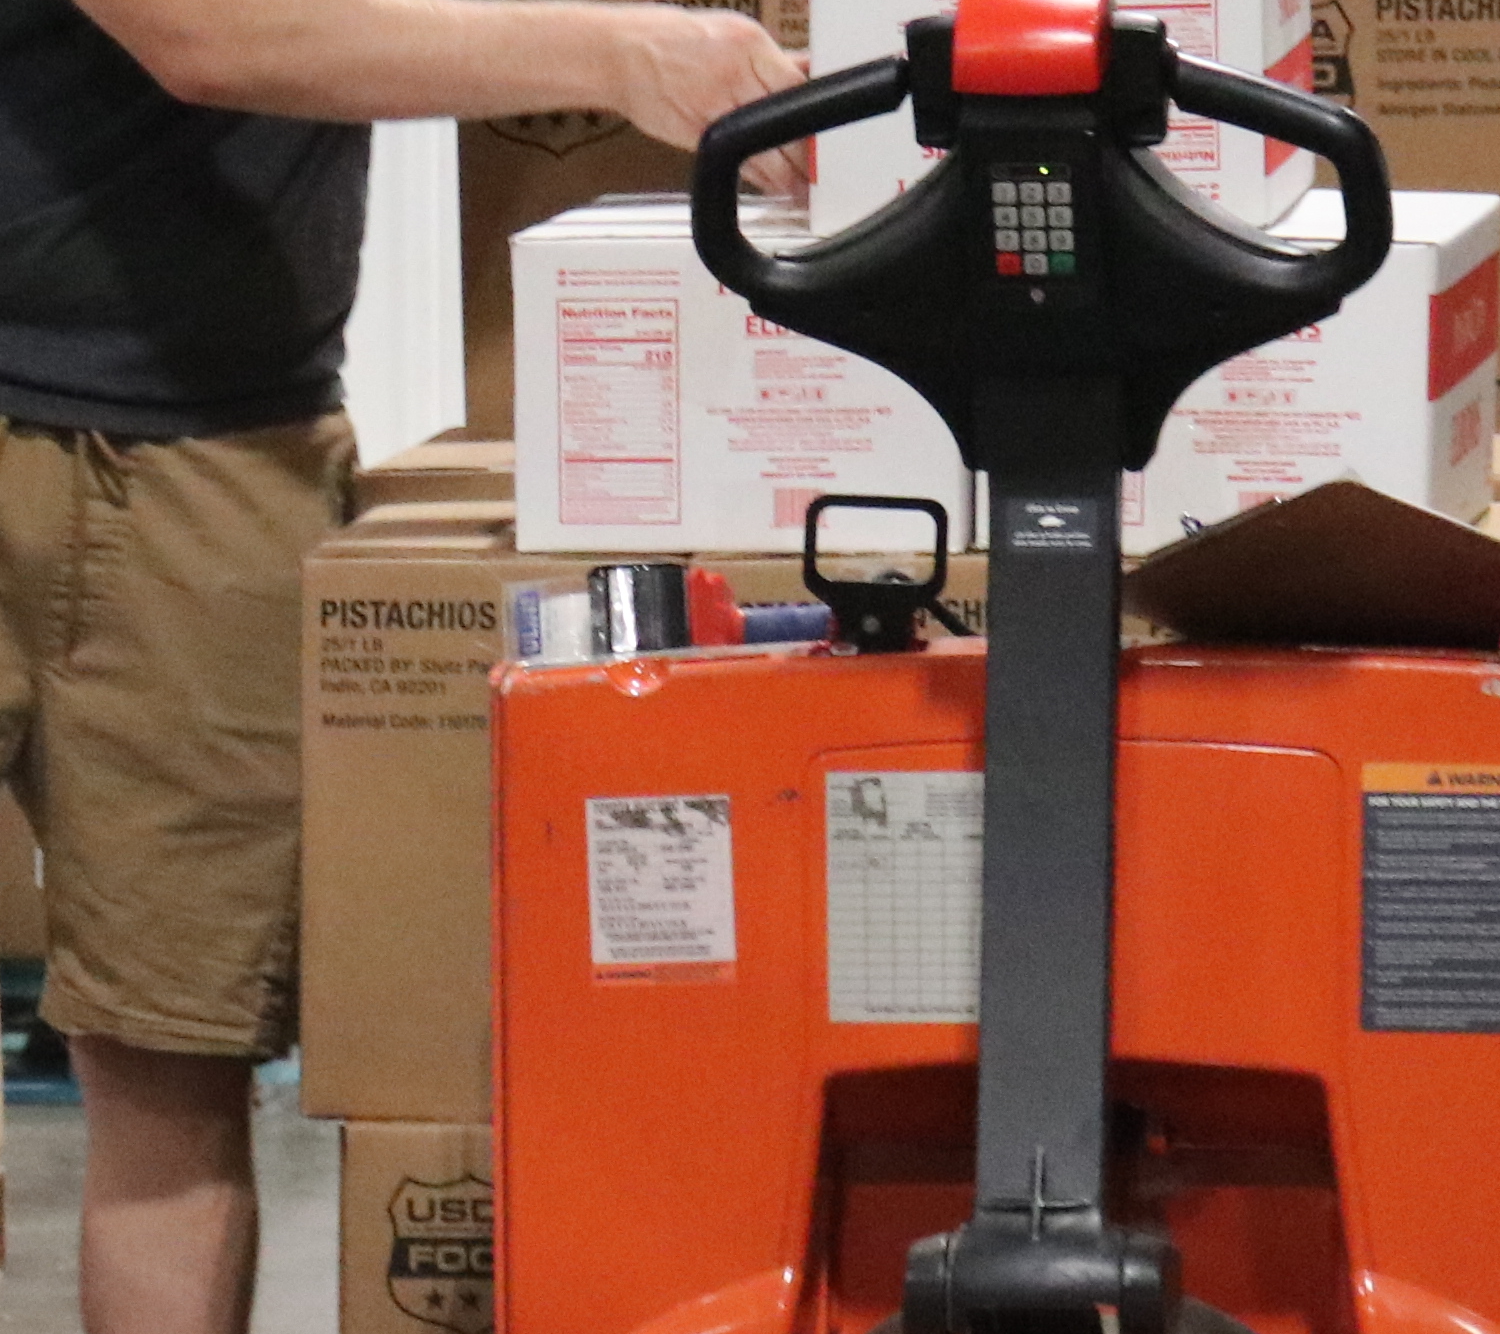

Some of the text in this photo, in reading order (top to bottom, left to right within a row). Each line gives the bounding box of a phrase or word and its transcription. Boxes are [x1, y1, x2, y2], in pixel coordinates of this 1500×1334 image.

[561, 306, 627, 319] Nutrition
[321, 599, 497, 630] PISTACHIOS
[320, 658, 382, 674] PACKED
[406, 1198, 495, 1224] USD
